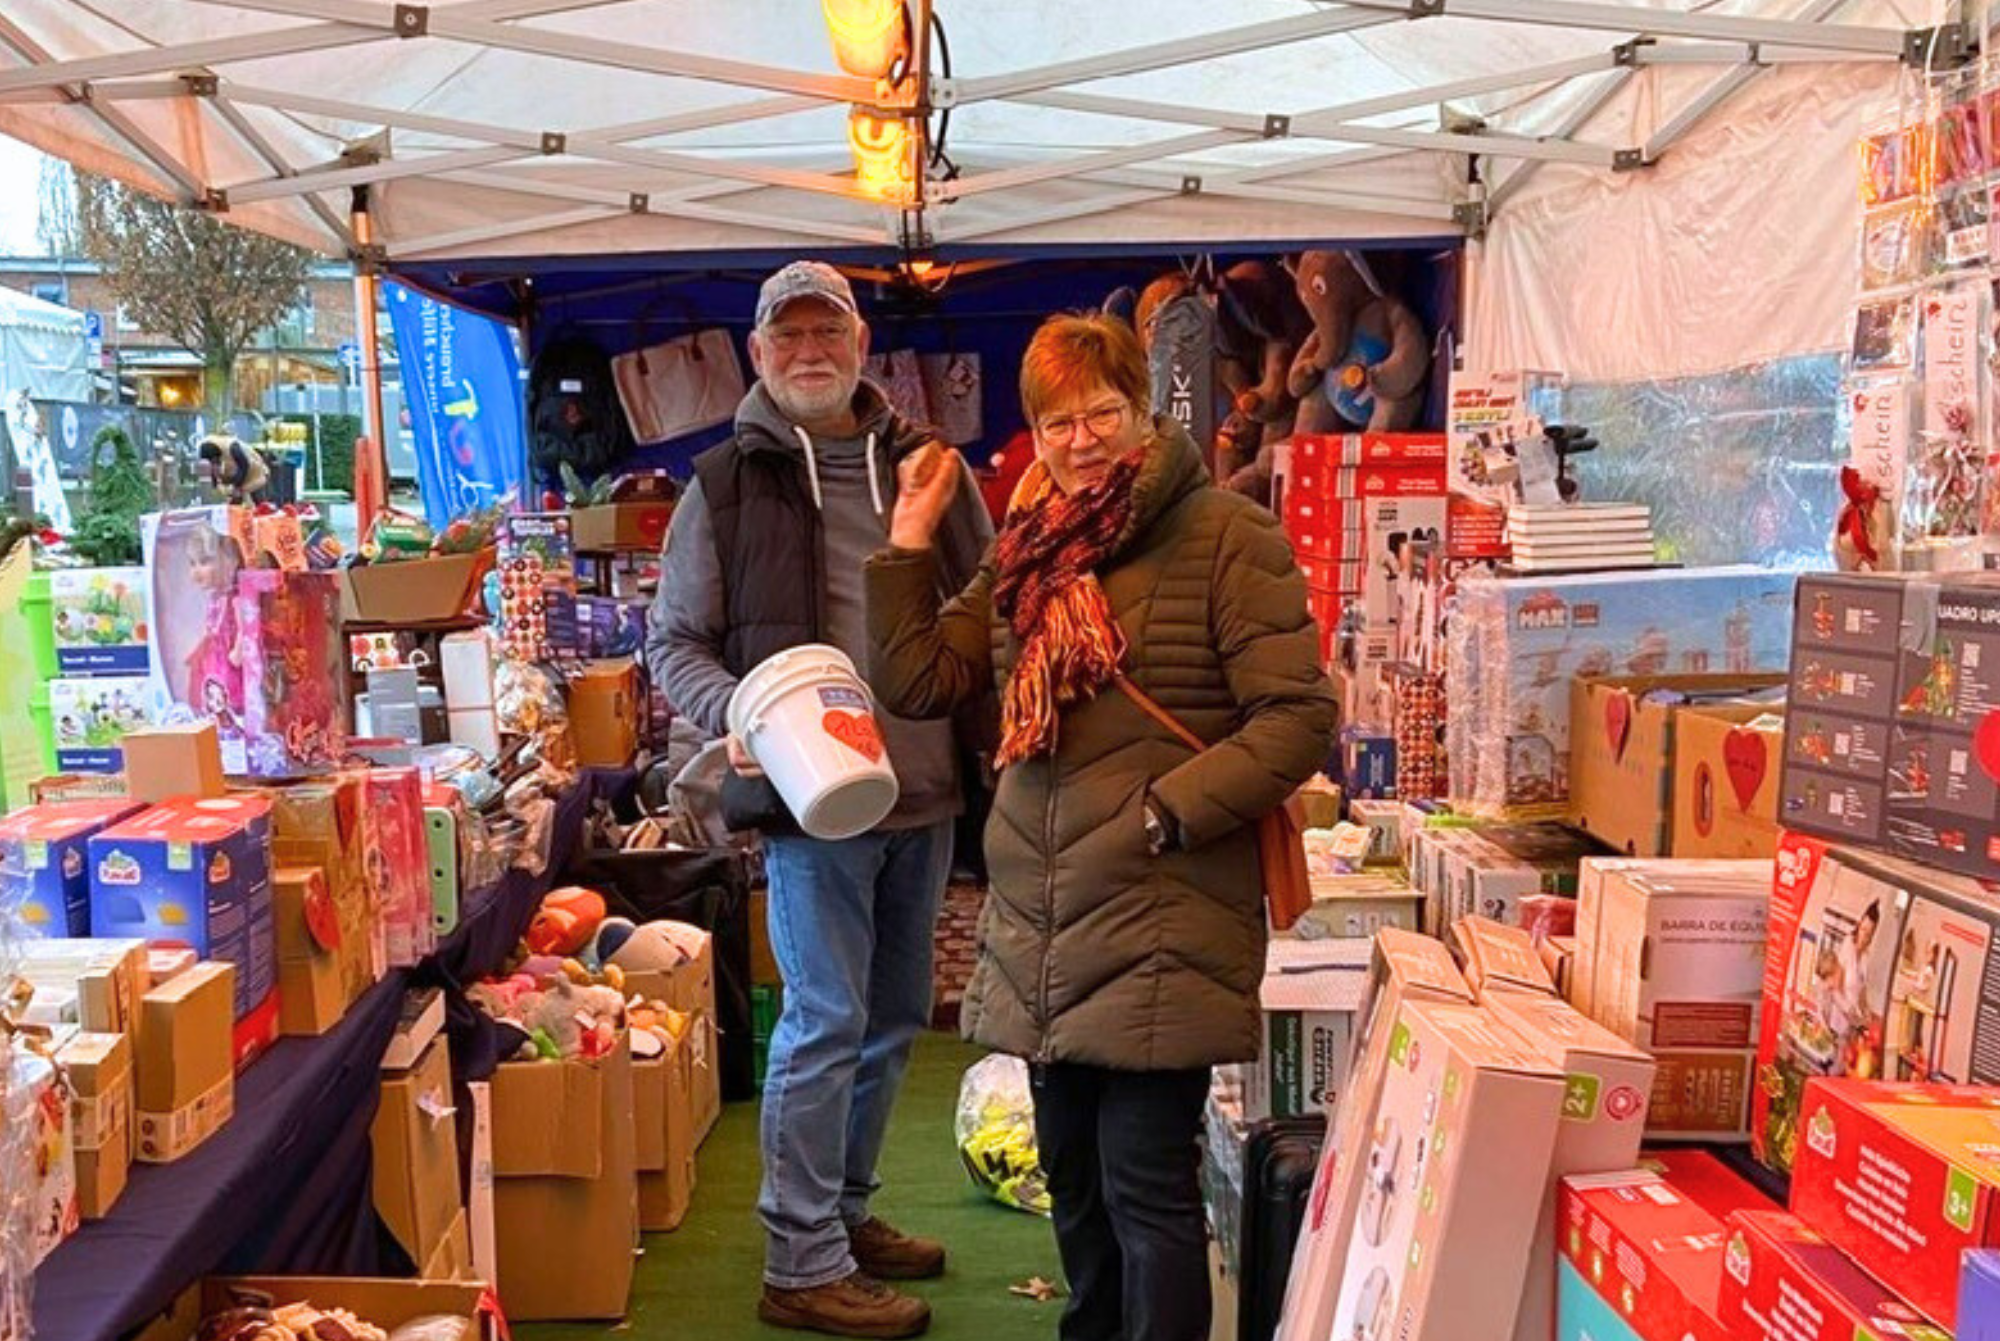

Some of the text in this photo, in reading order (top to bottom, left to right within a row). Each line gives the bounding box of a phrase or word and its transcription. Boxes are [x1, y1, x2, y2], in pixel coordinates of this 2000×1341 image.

[1173, 373, 1191, 429] SK
[1938, 605, 2000, 624] UADRO UP
[1660, 919, 1706, 931] BARRA
[1709, 920, 1727, 931] DE
